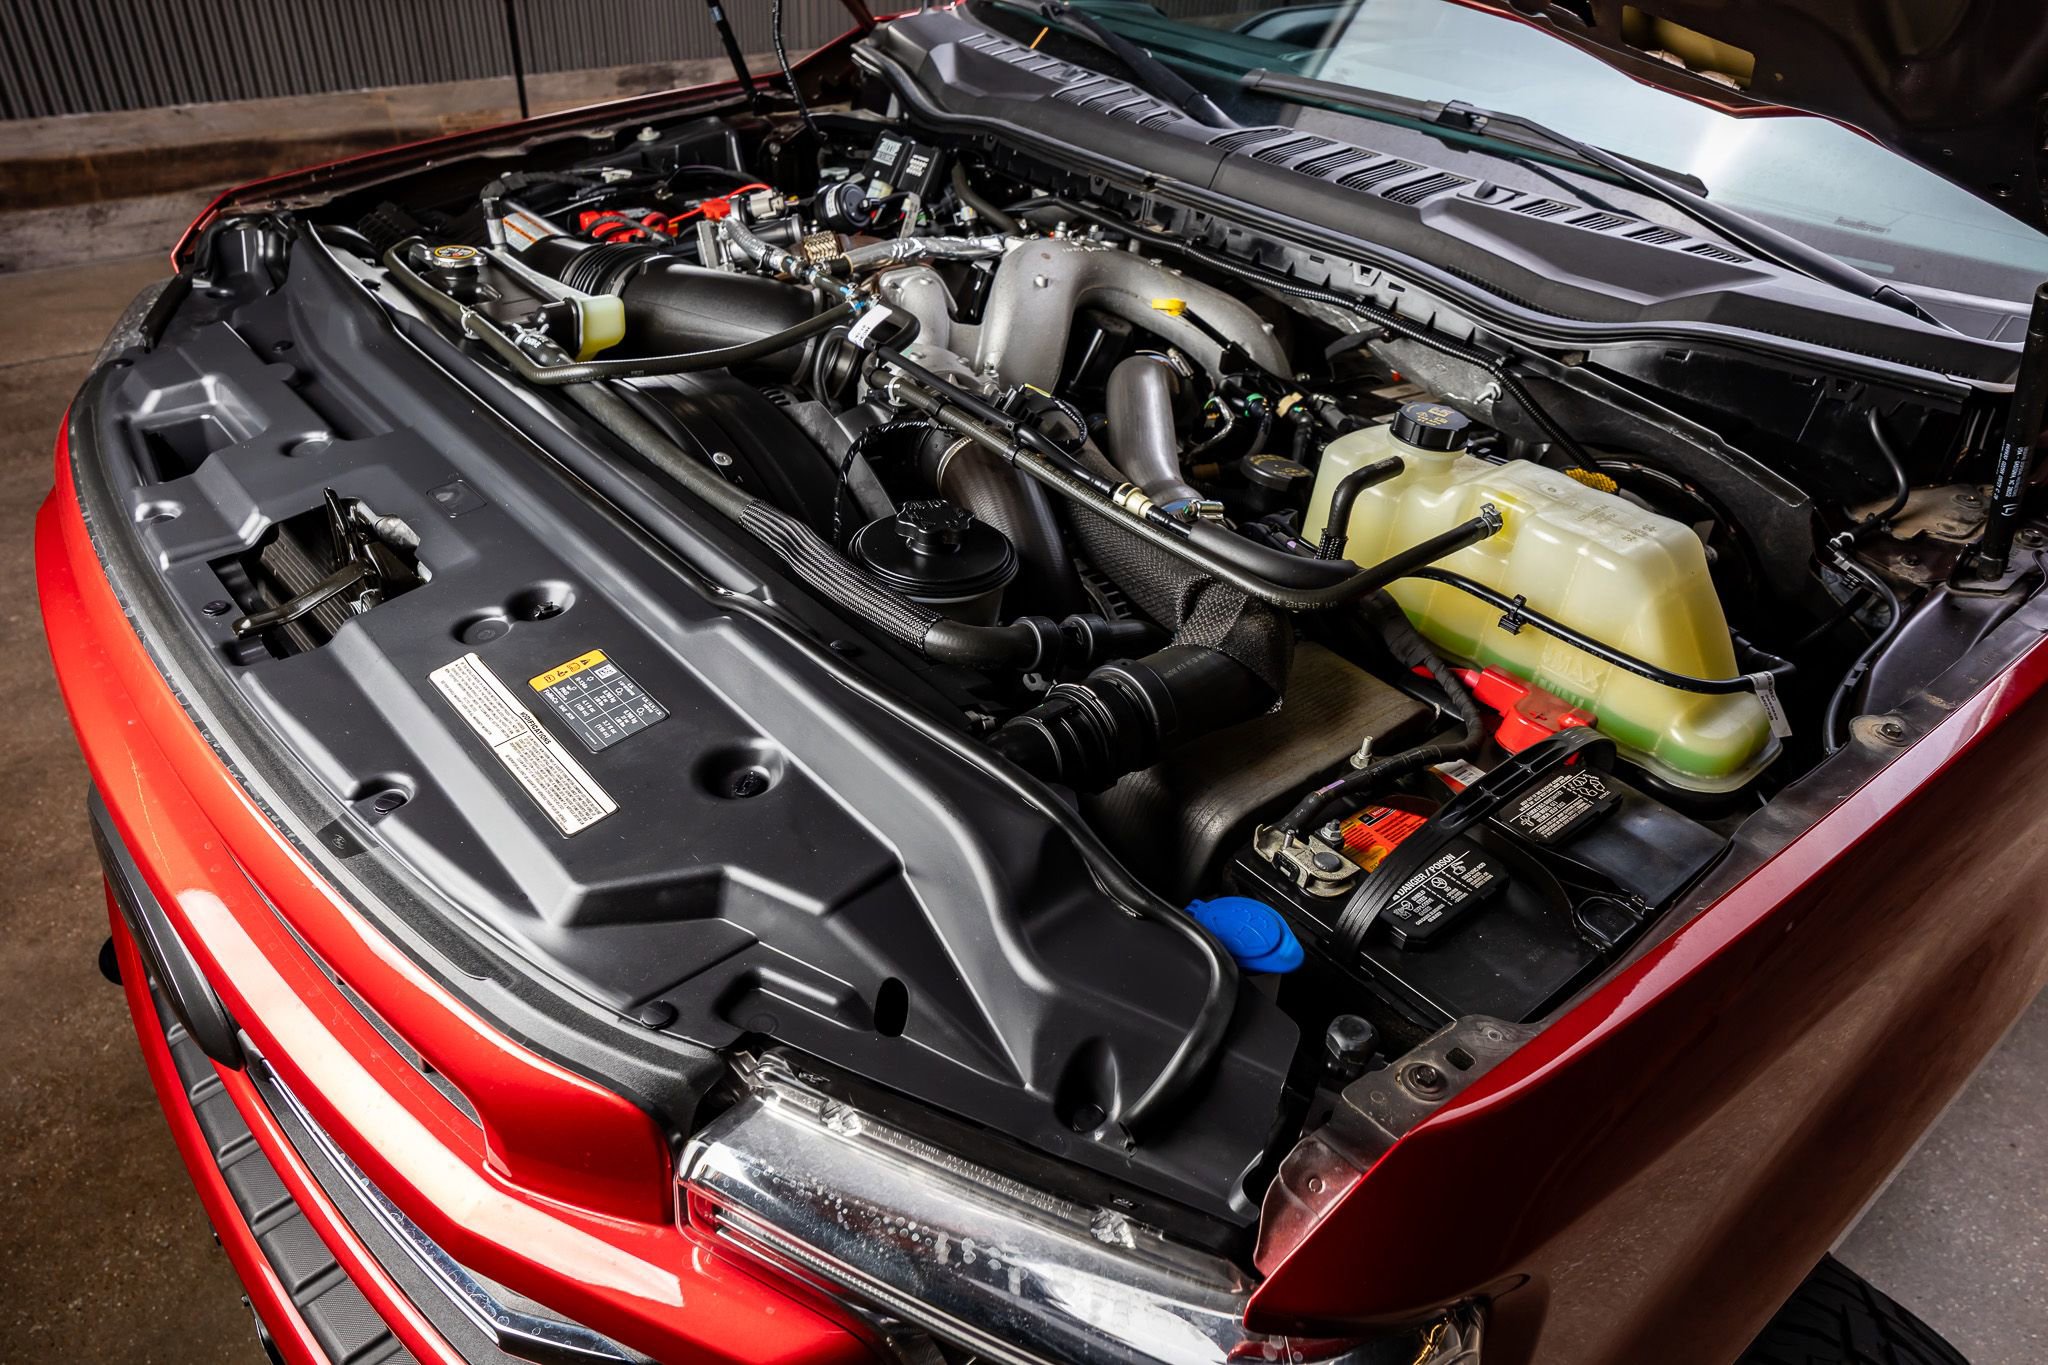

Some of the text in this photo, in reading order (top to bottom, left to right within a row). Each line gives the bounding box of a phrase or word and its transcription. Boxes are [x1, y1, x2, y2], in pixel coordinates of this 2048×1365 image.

[520, 711, 551, 745] MODIFICATIONS
[1397, 872, 1427, 895] DANGER
[1430, 853, 1456, 873] POISON
